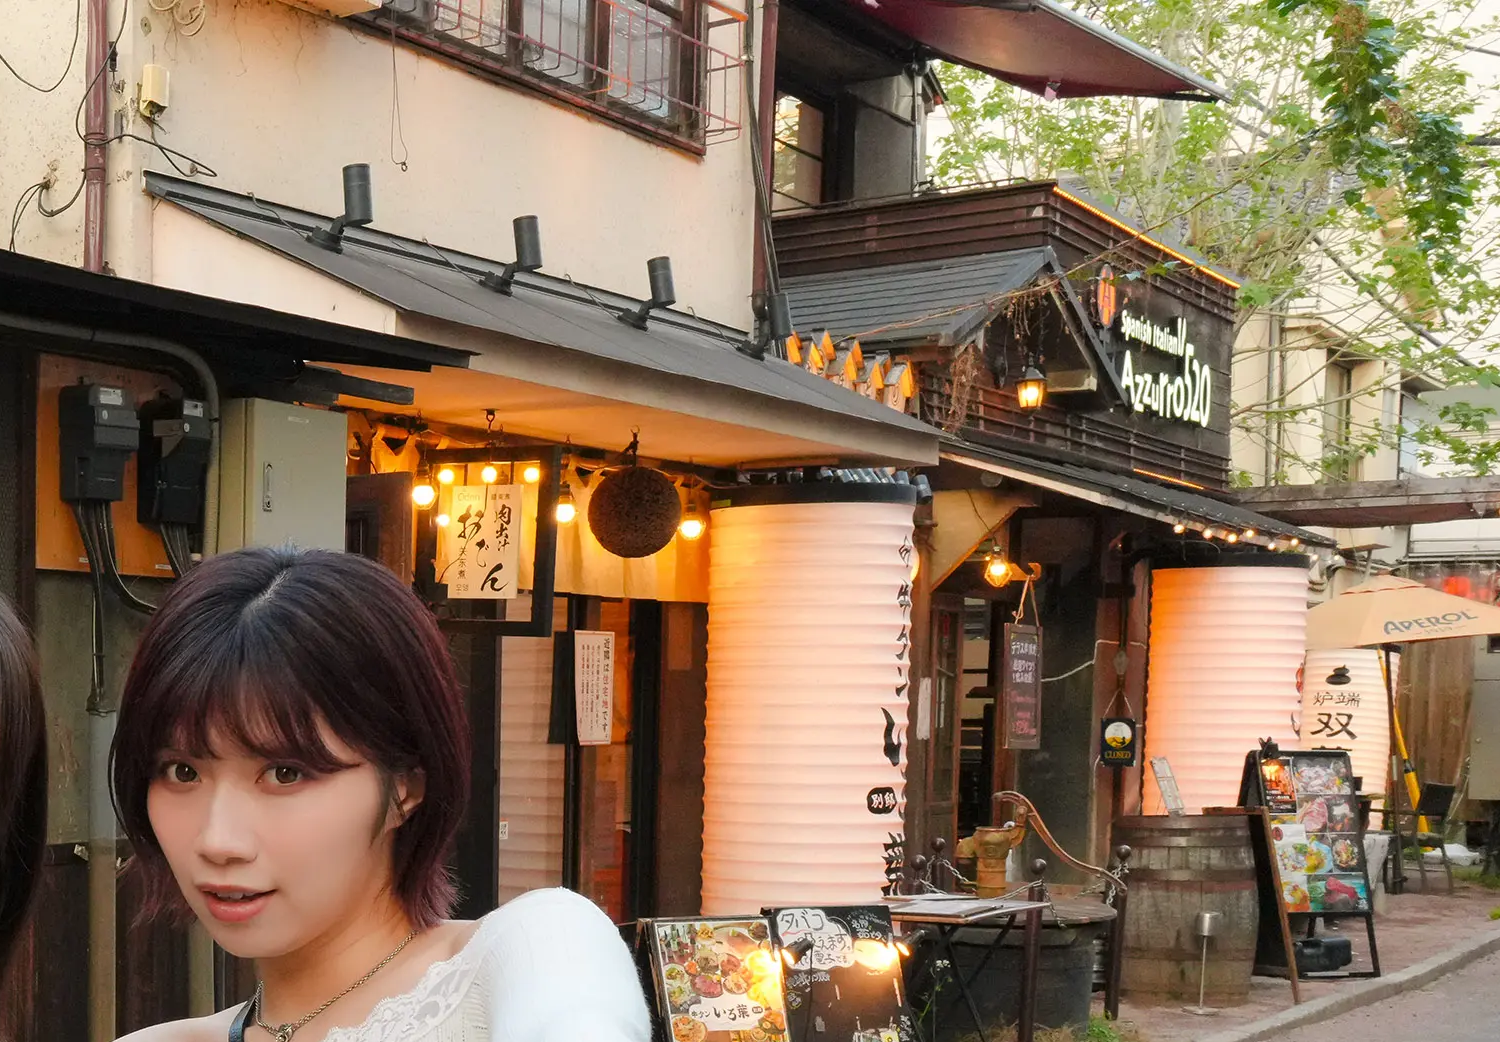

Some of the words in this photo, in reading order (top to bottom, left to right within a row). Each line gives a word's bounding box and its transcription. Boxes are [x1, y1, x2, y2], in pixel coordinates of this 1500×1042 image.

[1121, 309, 1152, 345] Spanish
[1153, 323, 1178, 355] Italian
[1120, 343, 1211, 428] Azzurro520
[455, 504, 510, 592] おでん
[1383, 610, 1479, 635] APEROL
[1310, 712, 1357, 752] 双
[781, 909, 825, 932] タバコ
[713, 1003, 750, 1021] いろ葉
